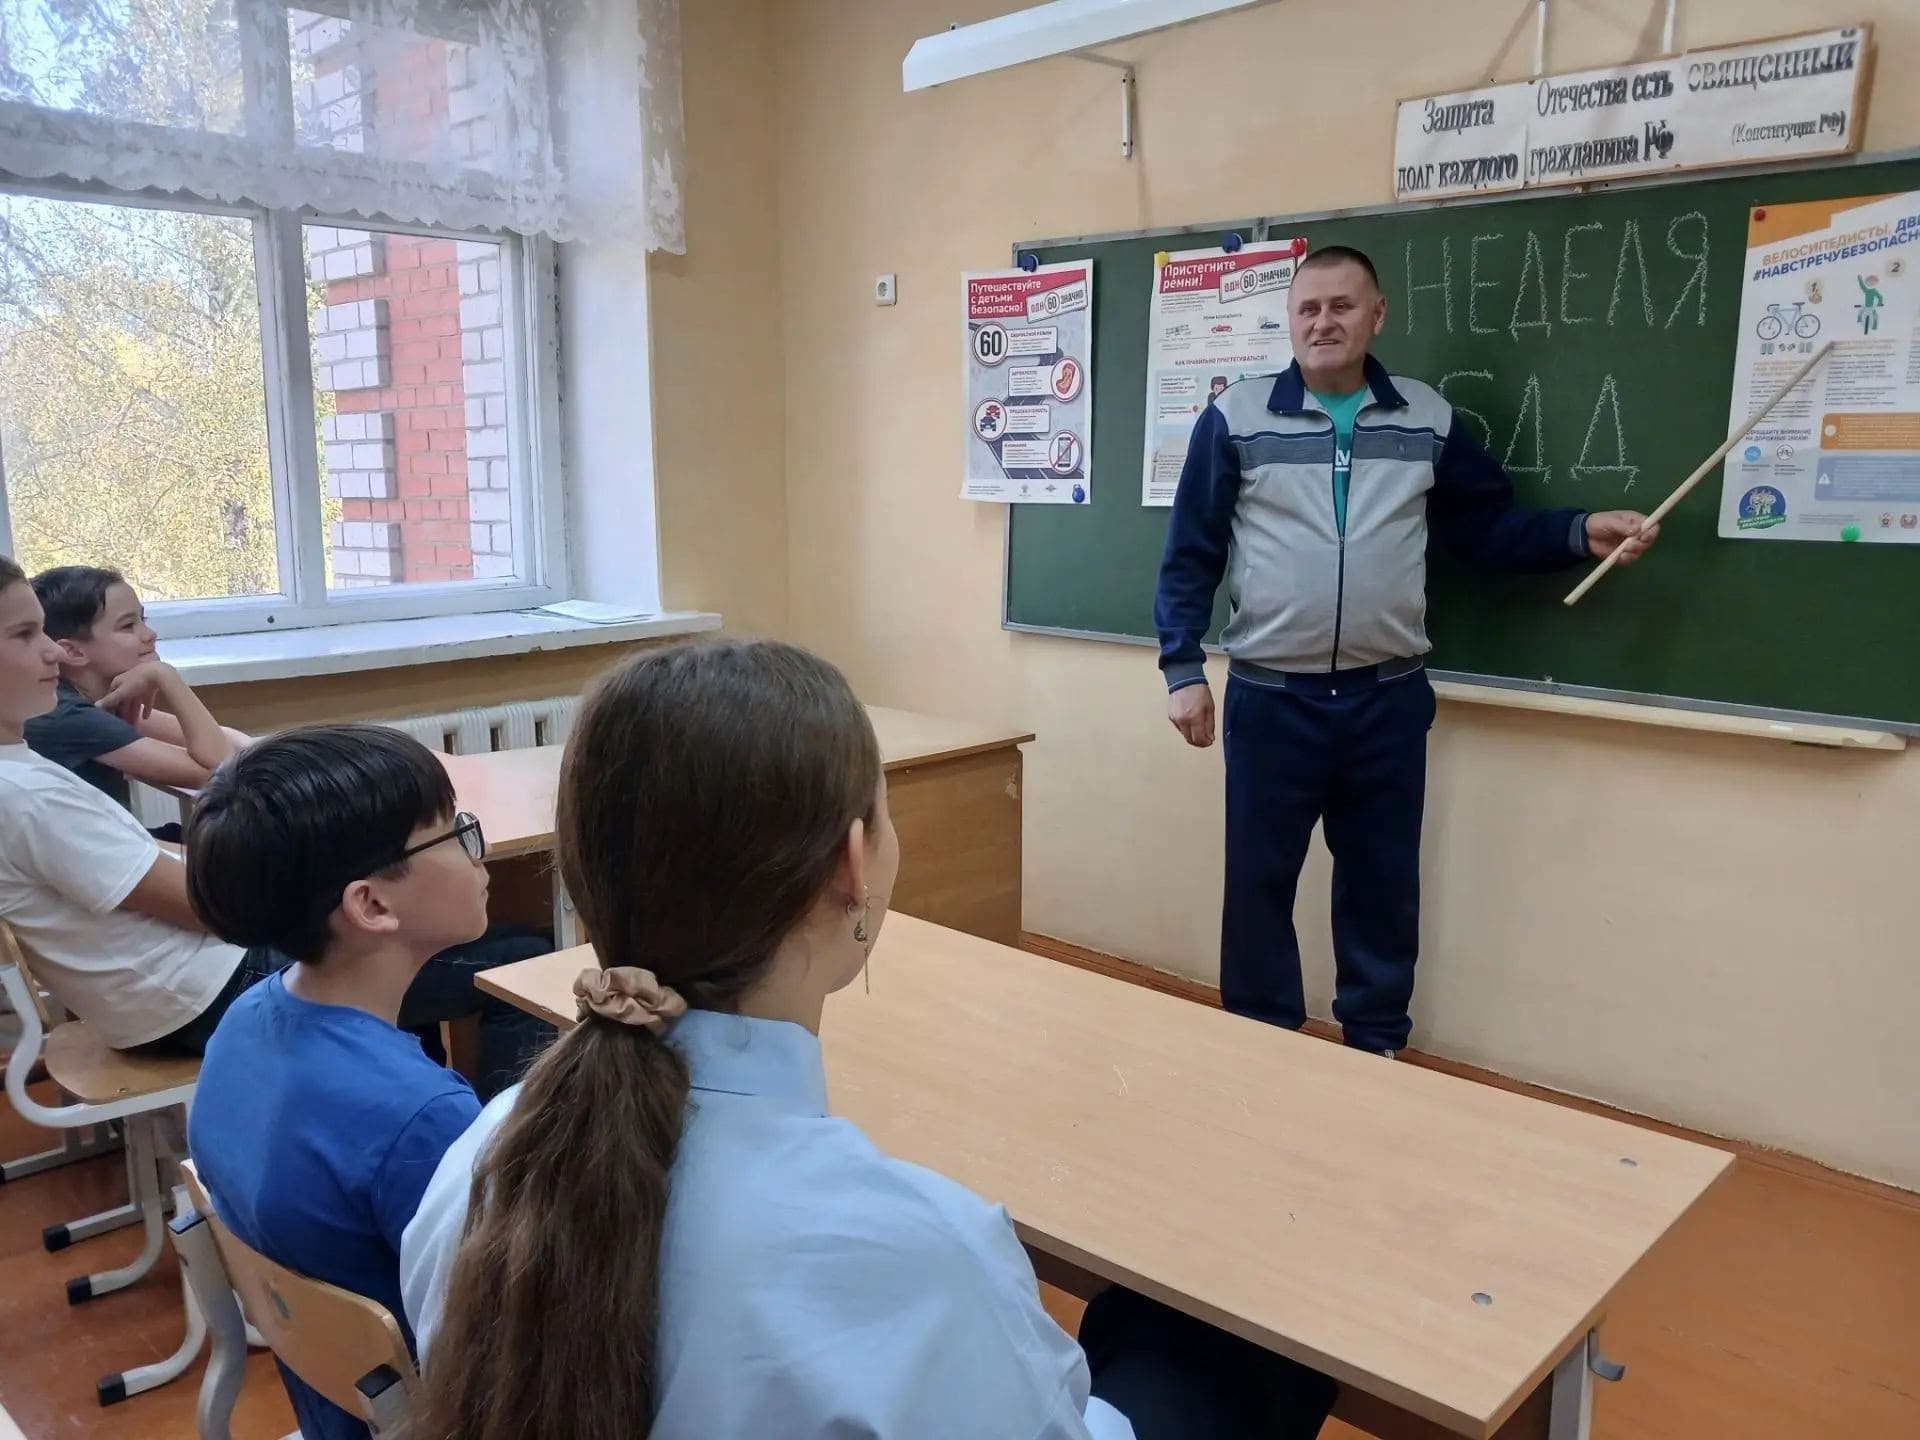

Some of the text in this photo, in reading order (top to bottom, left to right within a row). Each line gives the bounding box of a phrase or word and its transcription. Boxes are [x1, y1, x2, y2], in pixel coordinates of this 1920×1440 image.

[1423, 99, 1494, 135] Защита
[1537, 77, 1627, 117] Отечества
[1632, 70, 1674, 101] есть
[1397, 119, 1674, 197] долг каждого гражданина РФ
[1895, 213, 1920, 234] ДВ
[1753, 229, 1920, 281] #НАВСТРЕЧУБЕЗОПАСН
[1164, 260, 1236, 277] Пристегните
[1405, 210, 1709, 342] НЕДЕЛЯ
[970, 280, 1042, 293] Путешествуйте
[1162, 274, 1203, 292] ремни!
[971, 303, 1023, 315] безопасно!
[978, 294, 1013, 306] детьми
[980, 330, 1003, 357] 60
